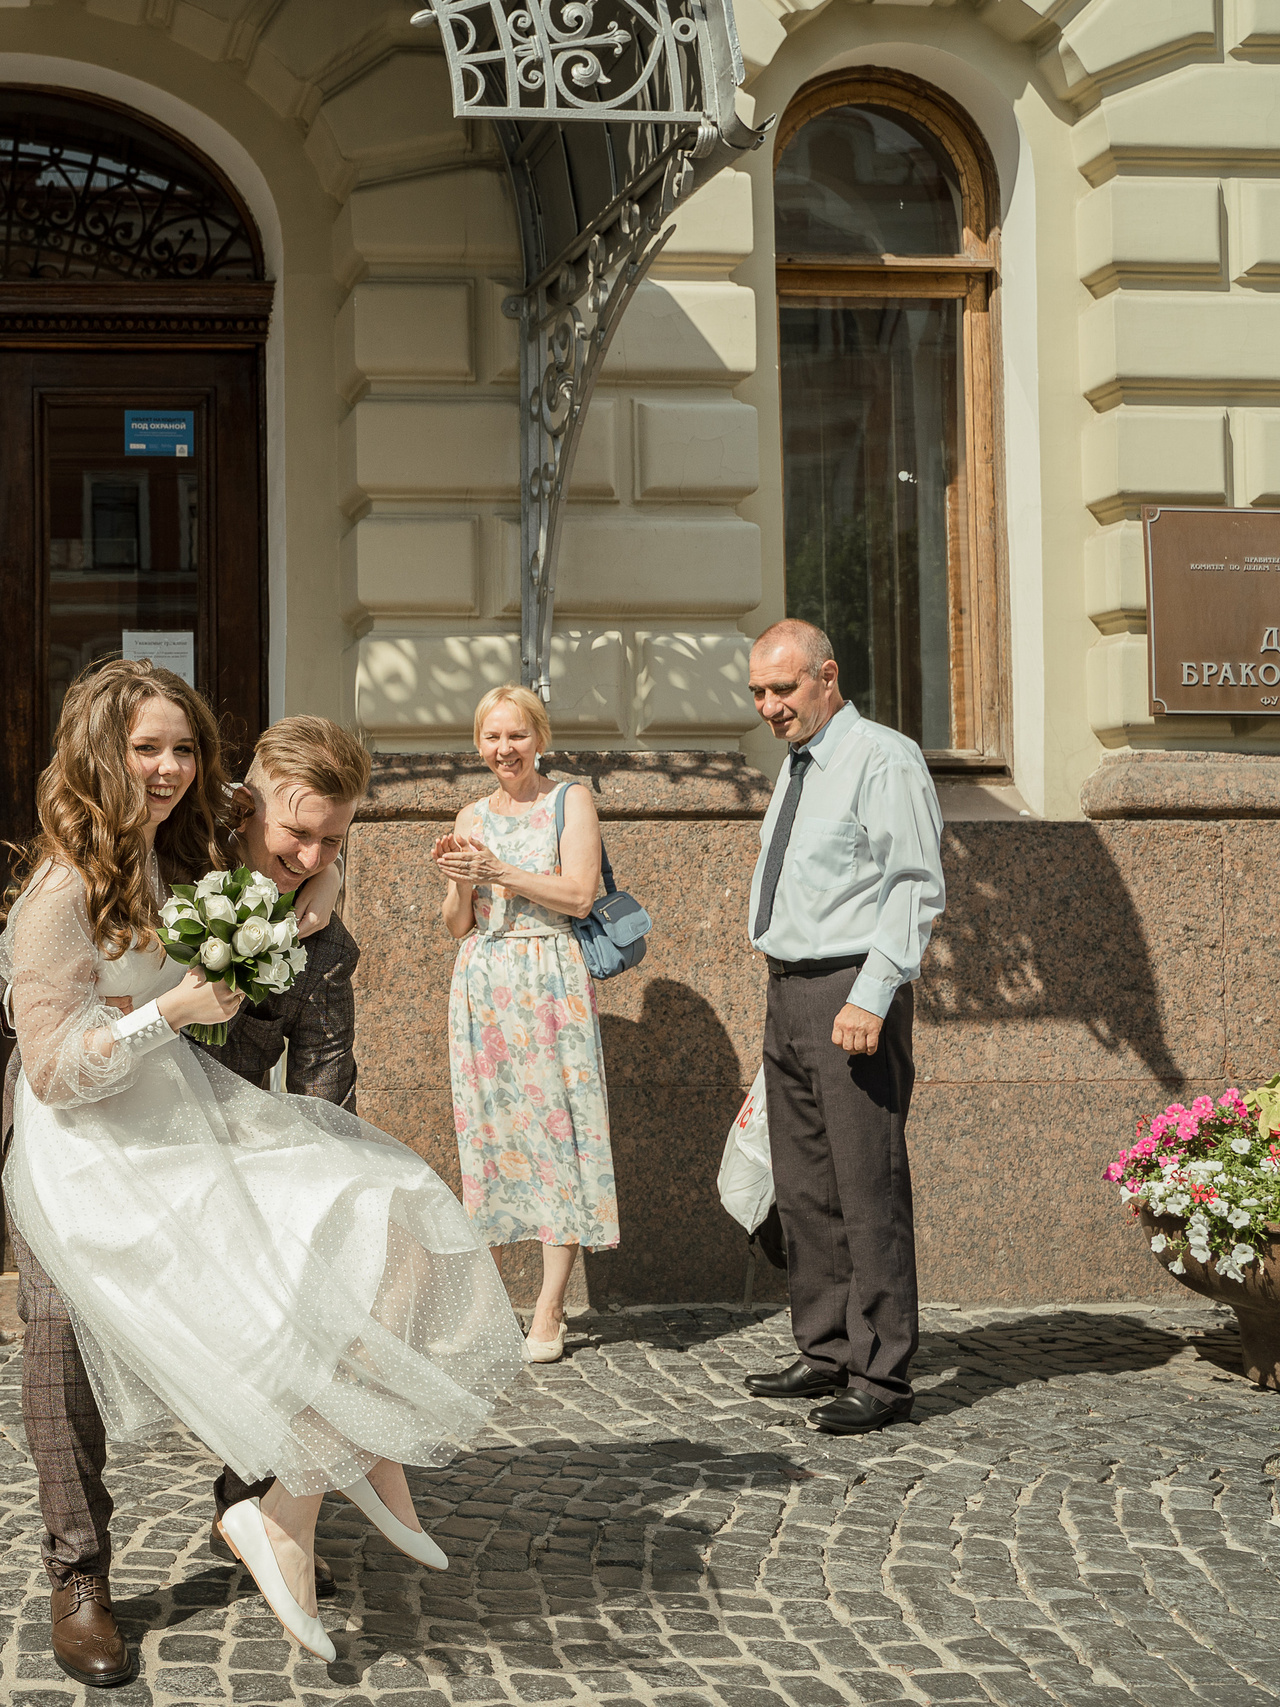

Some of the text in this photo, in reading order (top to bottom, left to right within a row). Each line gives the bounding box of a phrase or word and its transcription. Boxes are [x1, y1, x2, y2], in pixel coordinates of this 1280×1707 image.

[131, 422, 186, 430] ПОД ОХРАНОЙ
[1190, 563, 1225, 571] КОМИТЕТ
[1229, 563, 1240, 571] ПО
[1260, 626, 1280, 654] Д
[1181, 661, 1280, 687] БРАКО
